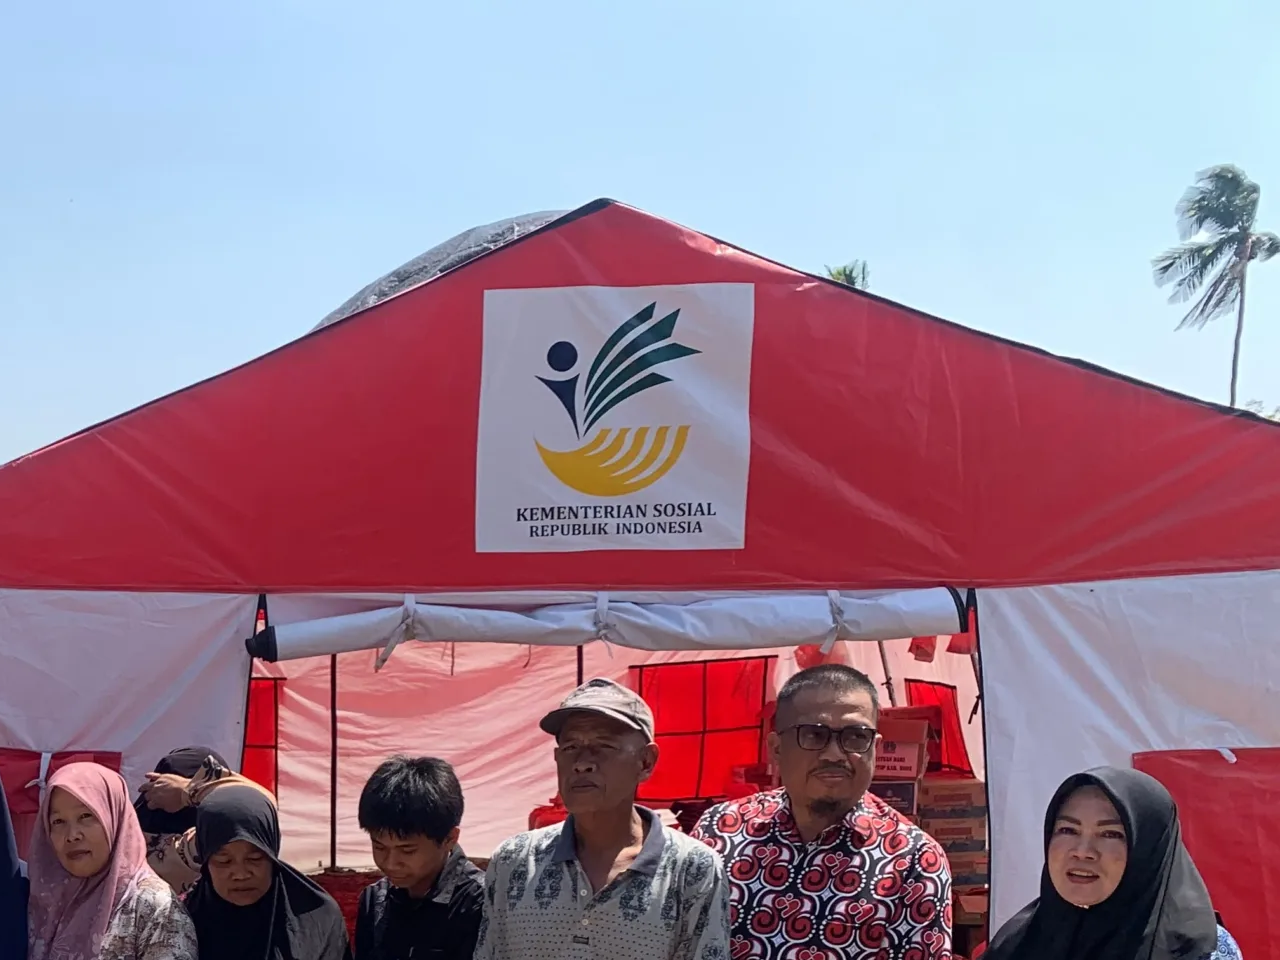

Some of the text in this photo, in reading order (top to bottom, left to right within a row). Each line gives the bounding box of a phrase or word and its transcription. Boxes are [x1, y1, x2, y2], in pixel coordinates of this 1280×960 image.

[517, 503, 716, 521] KEMENTERIAN SOSIAL
[530, 521, 702, 537] REPUBLIK INDONESIA
